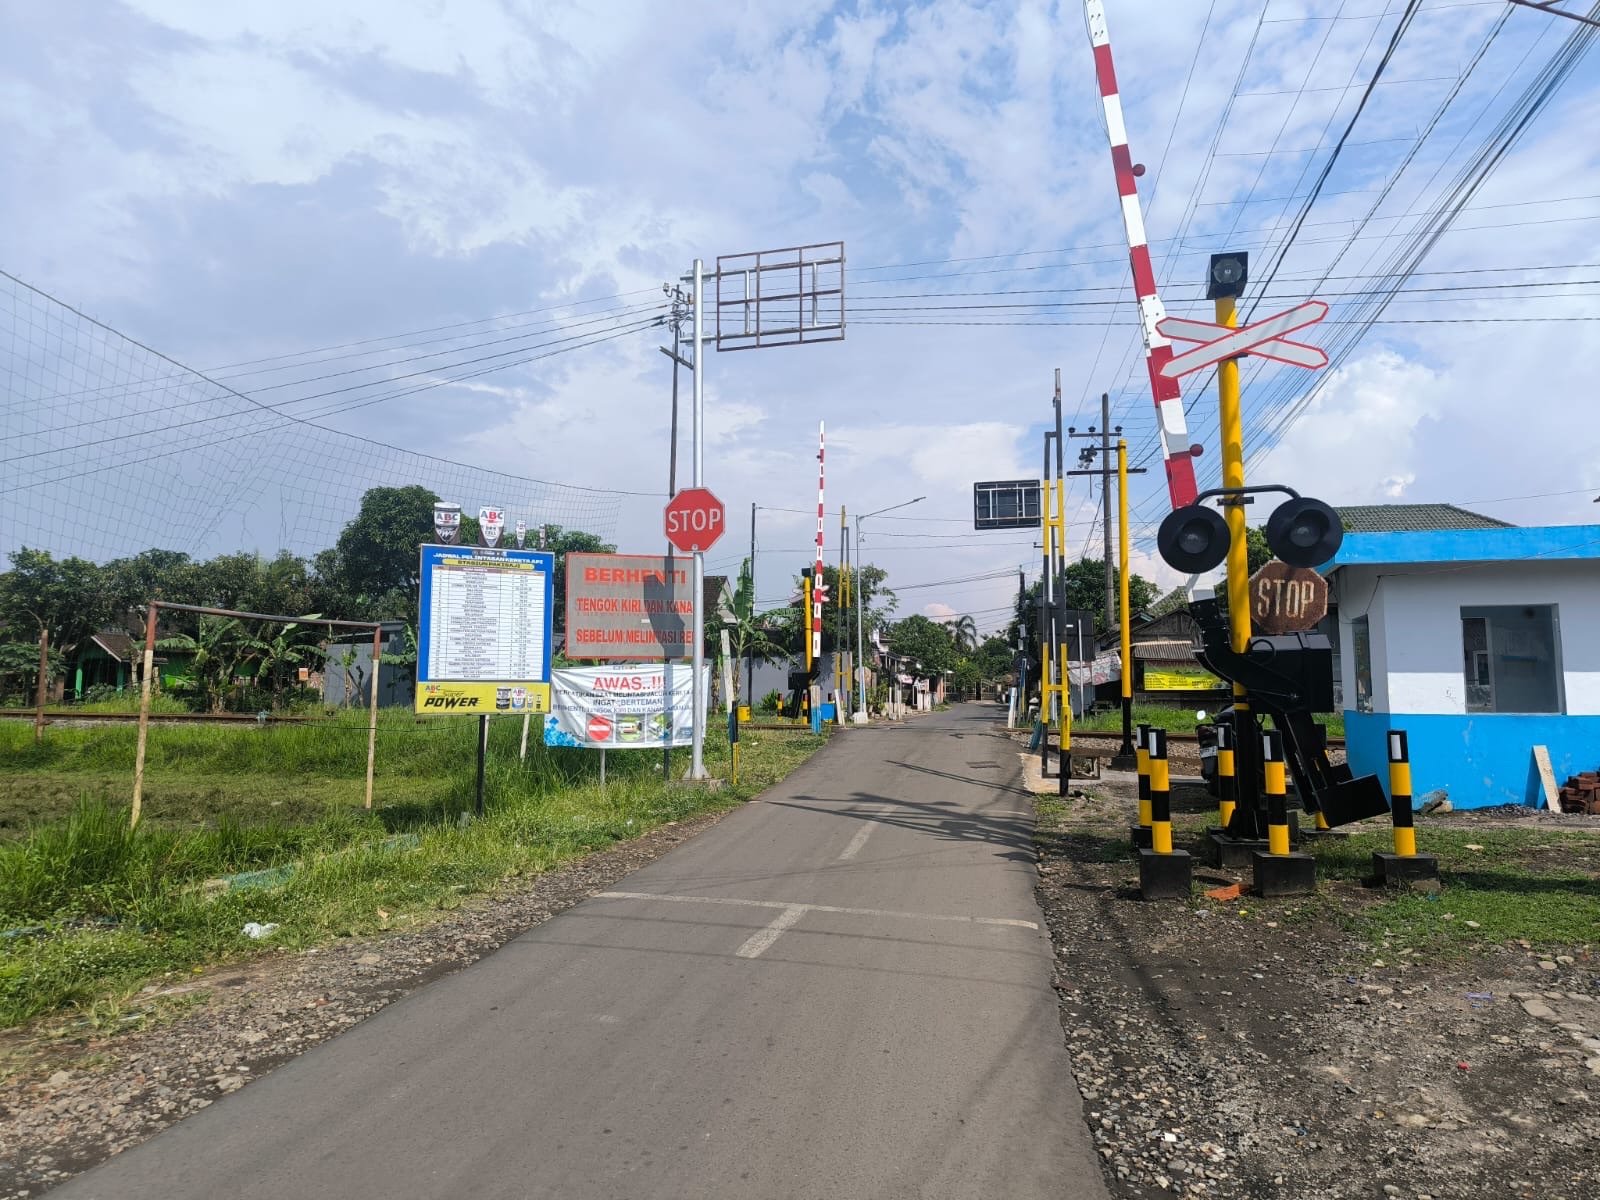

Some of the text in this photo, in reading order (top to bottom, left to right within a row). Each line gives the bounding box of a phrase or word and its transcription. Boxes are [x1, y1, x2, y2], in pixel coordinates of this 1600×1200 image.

[437, 511, 458, 521] ABC
[480, 510, 503, 520] ABC
[668, 508, 721, 532] STOP
[584, 567, 686, 585] BERHENTI
[576, 598, 693, 614] TENGOK KIRI DAN KANA
[1257, 578, 1315, 618] STOP
[576, 628, 694, 645] SEBELUM MELINTASI RE
[424, 697, 479, 709] POWER
